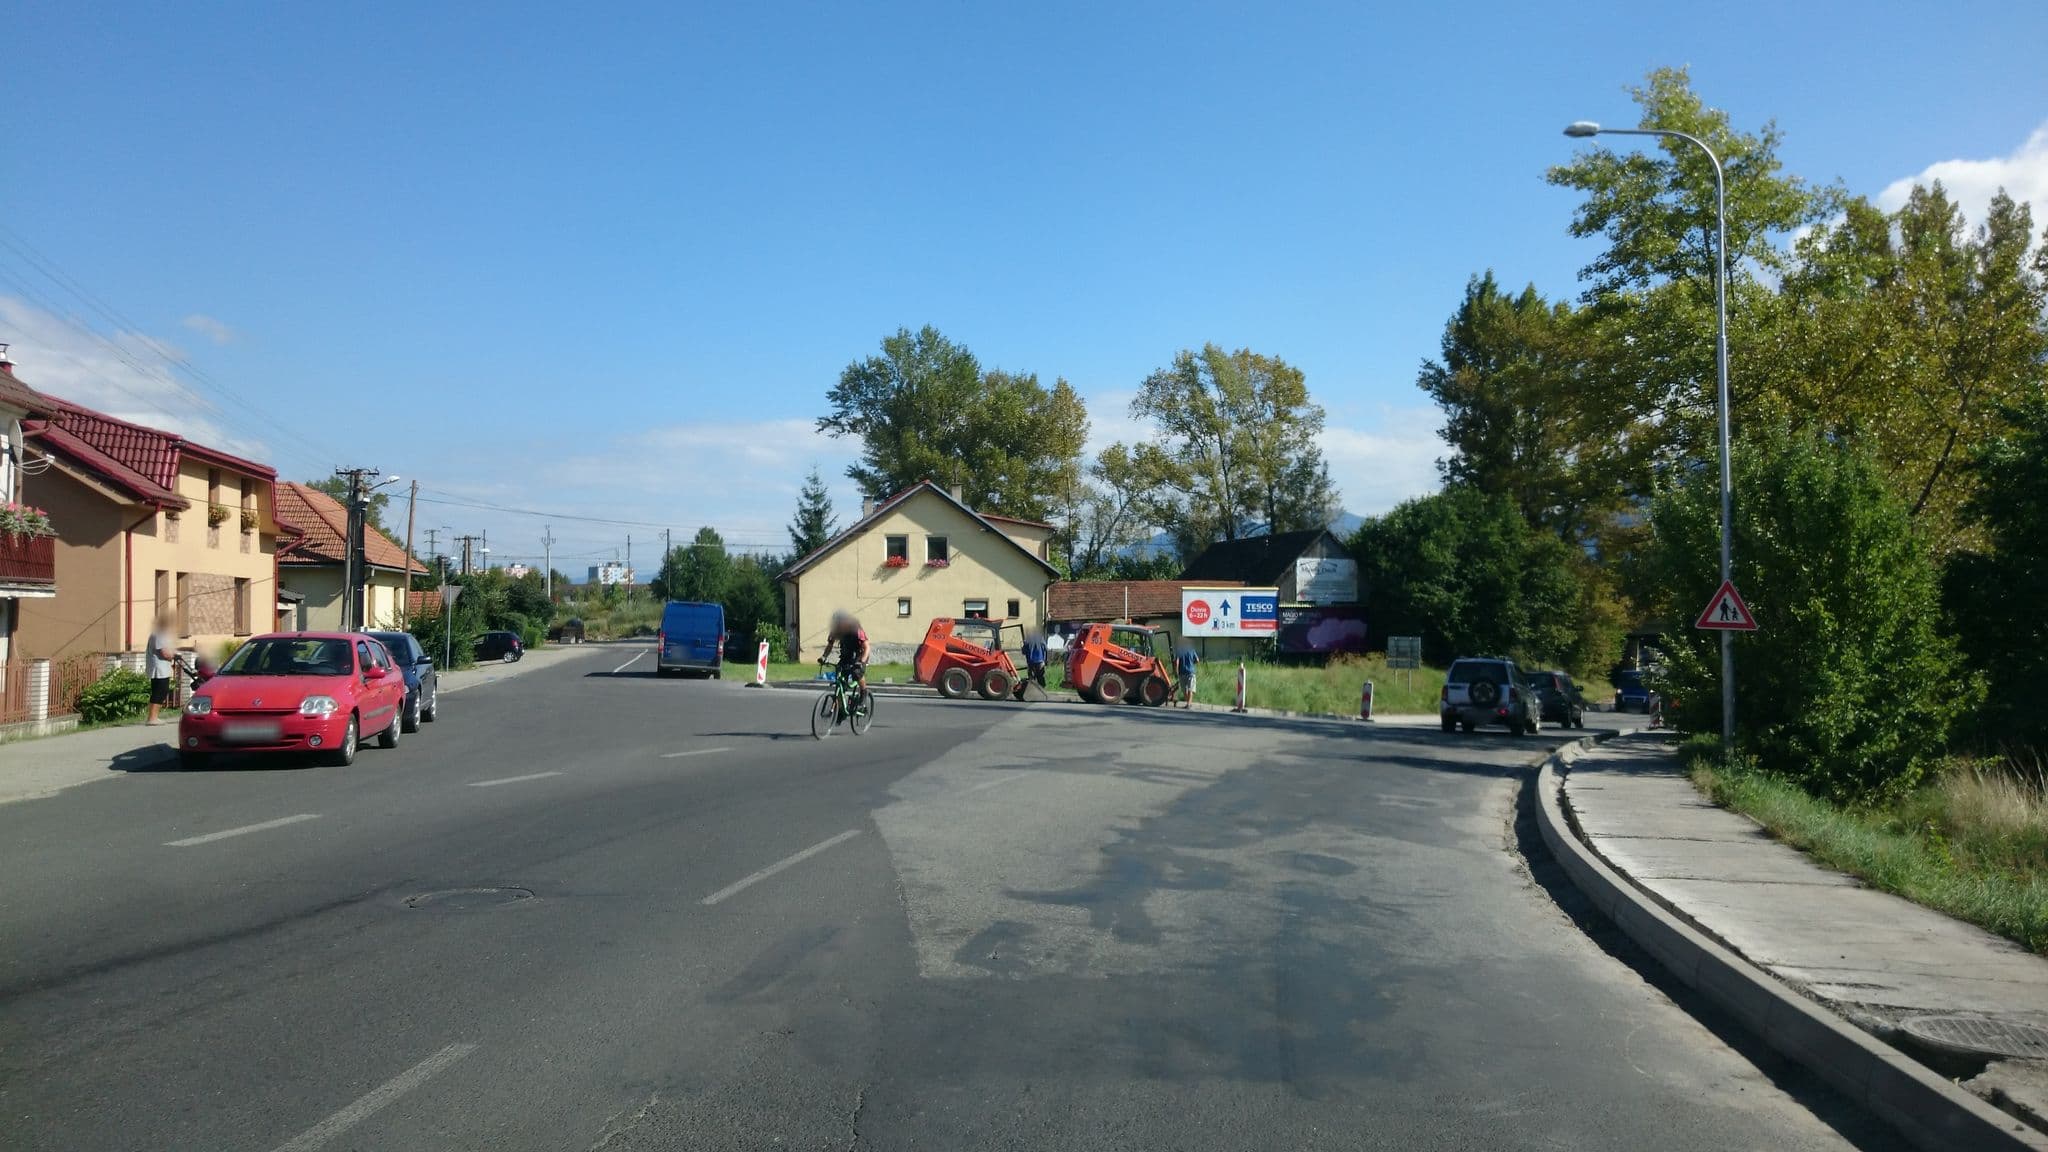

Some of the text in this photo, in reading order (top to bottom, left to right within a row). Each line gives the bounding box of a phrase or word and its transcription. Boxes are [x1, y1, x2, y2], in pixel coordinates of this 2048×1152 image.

[1246, 603, 1273, 611] TESCO
[1221, 621, 1235, 629] 3 km
[964, 643, 990, 656] LOCUST
[1120, 649, 1143, 661] LOCUST
